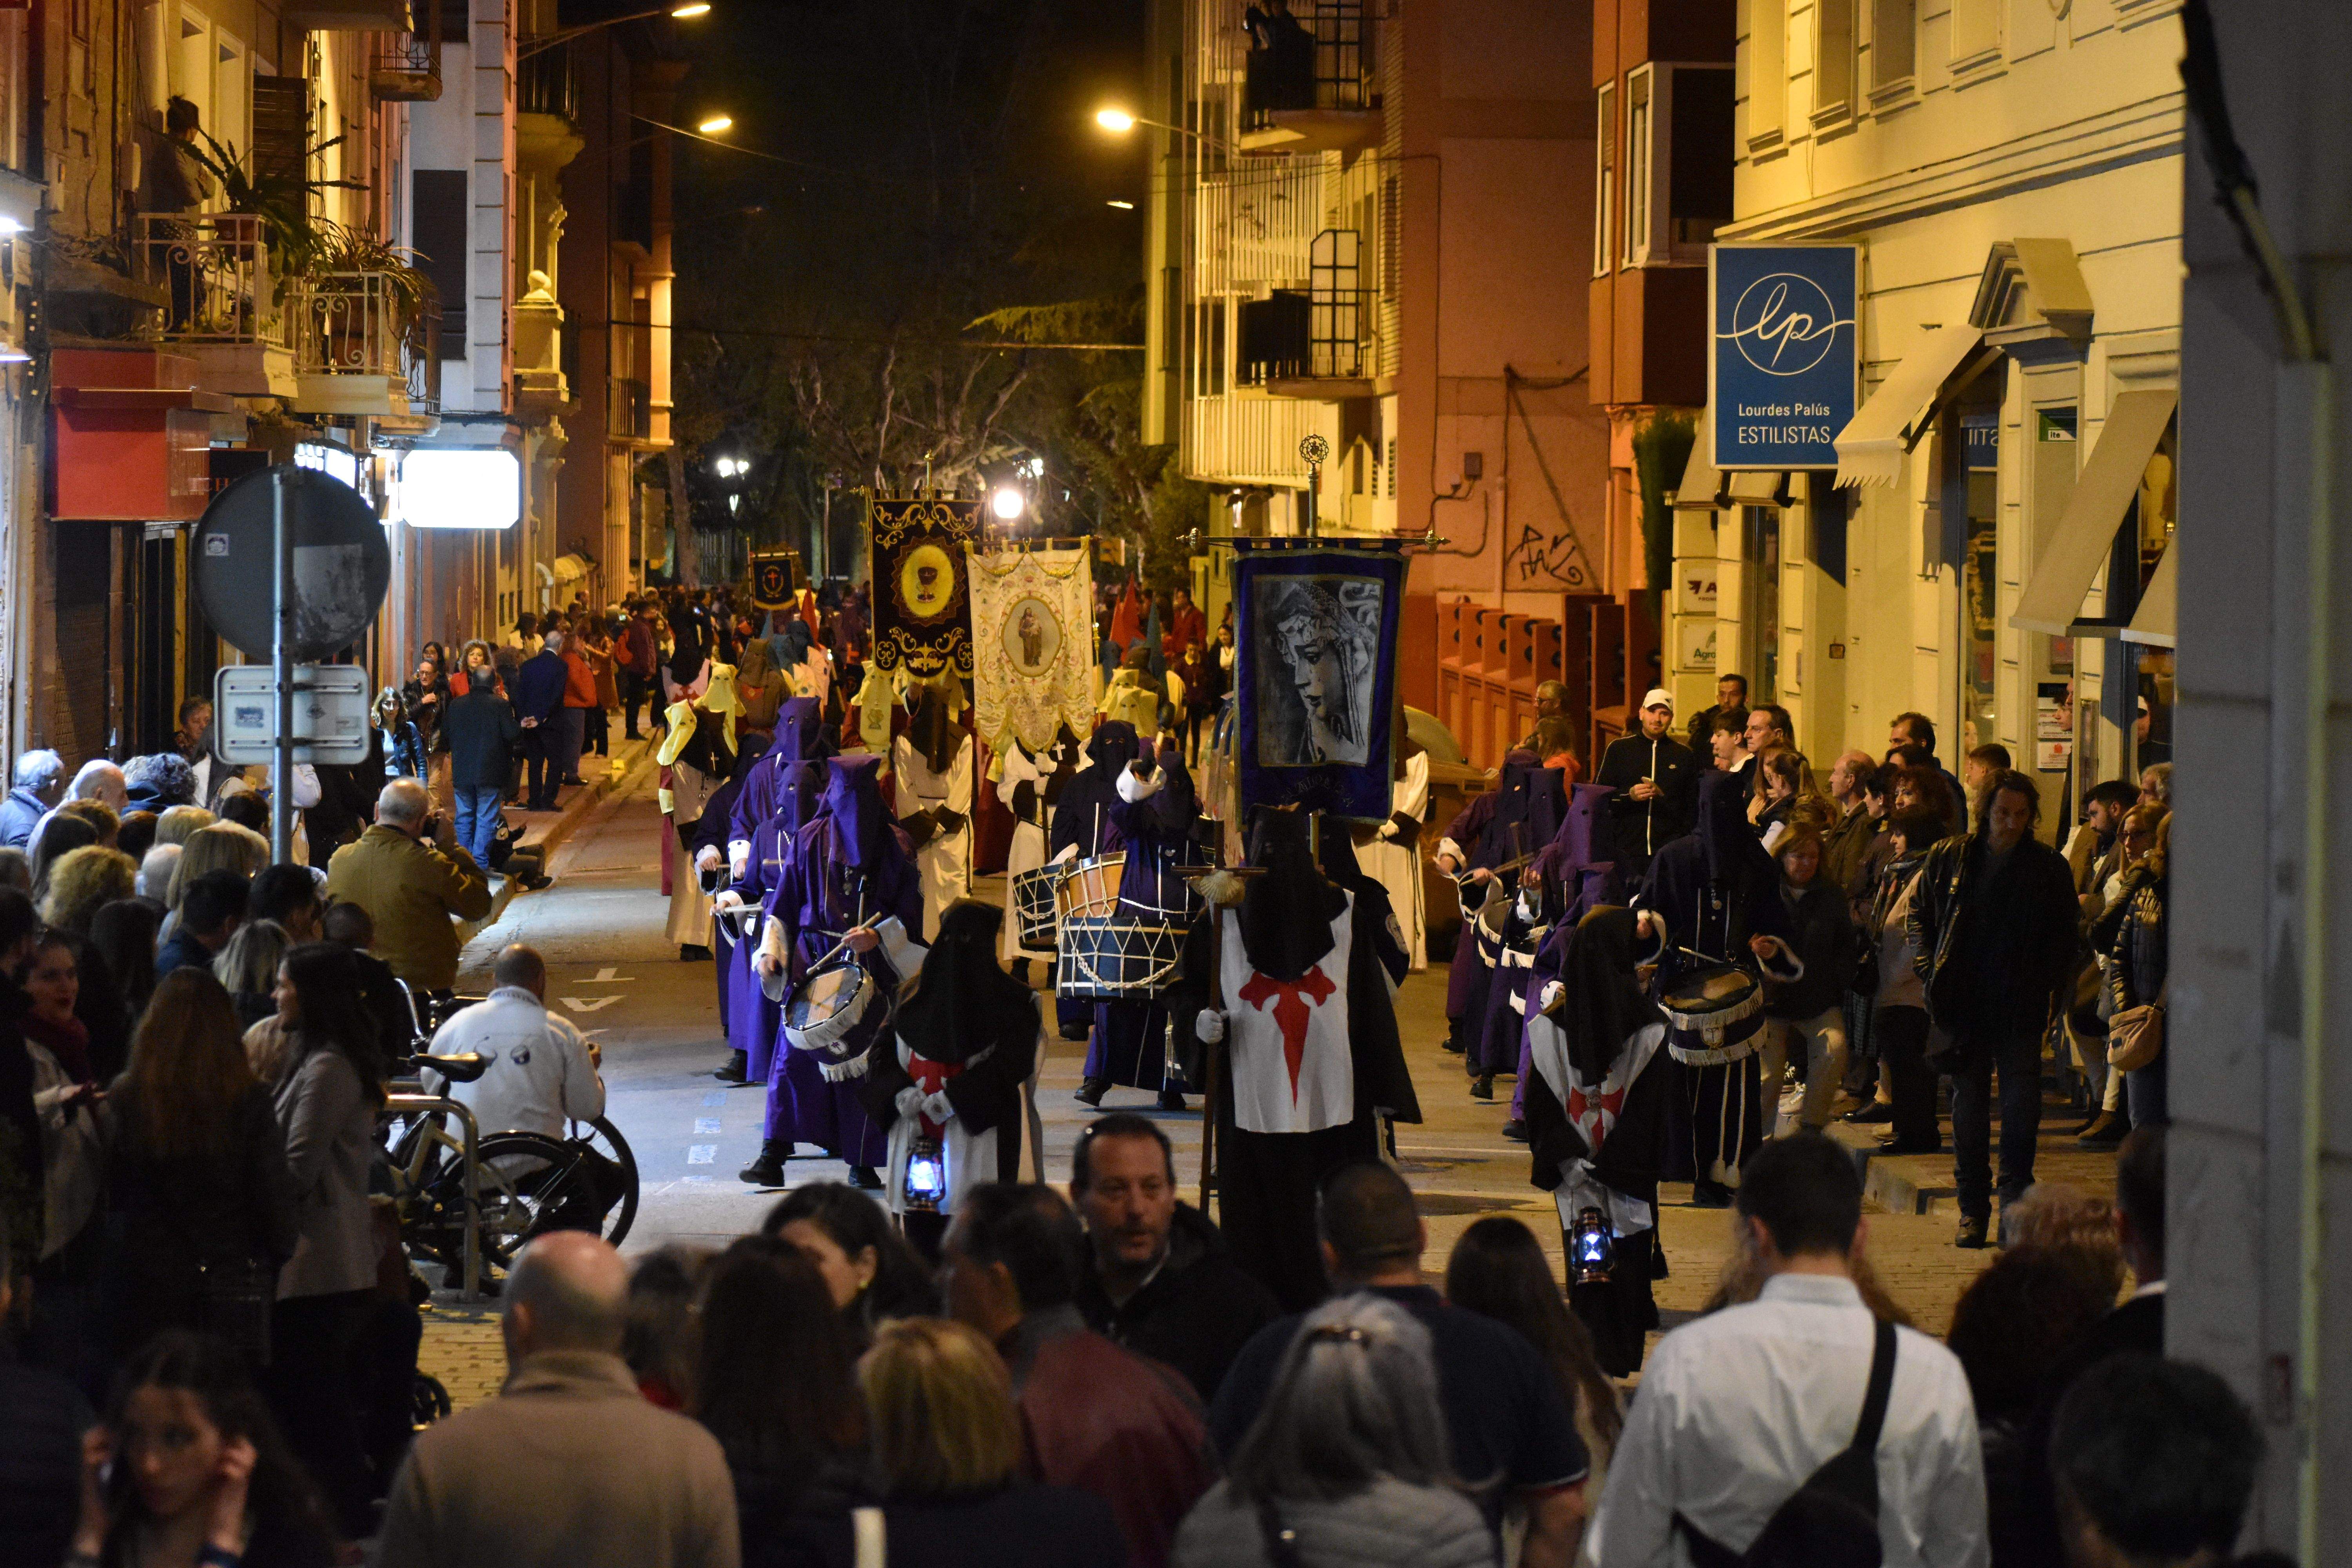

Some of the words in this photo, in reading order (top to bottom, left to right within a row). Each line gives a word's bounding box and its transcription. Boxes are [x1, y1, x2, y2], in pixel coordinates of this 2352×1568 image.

[1739, 403, 1790, 417] Lourdes
[1795, 401, 1830, 417] Palús
[1739, 426, 1830, 444] ESTILISTAS
